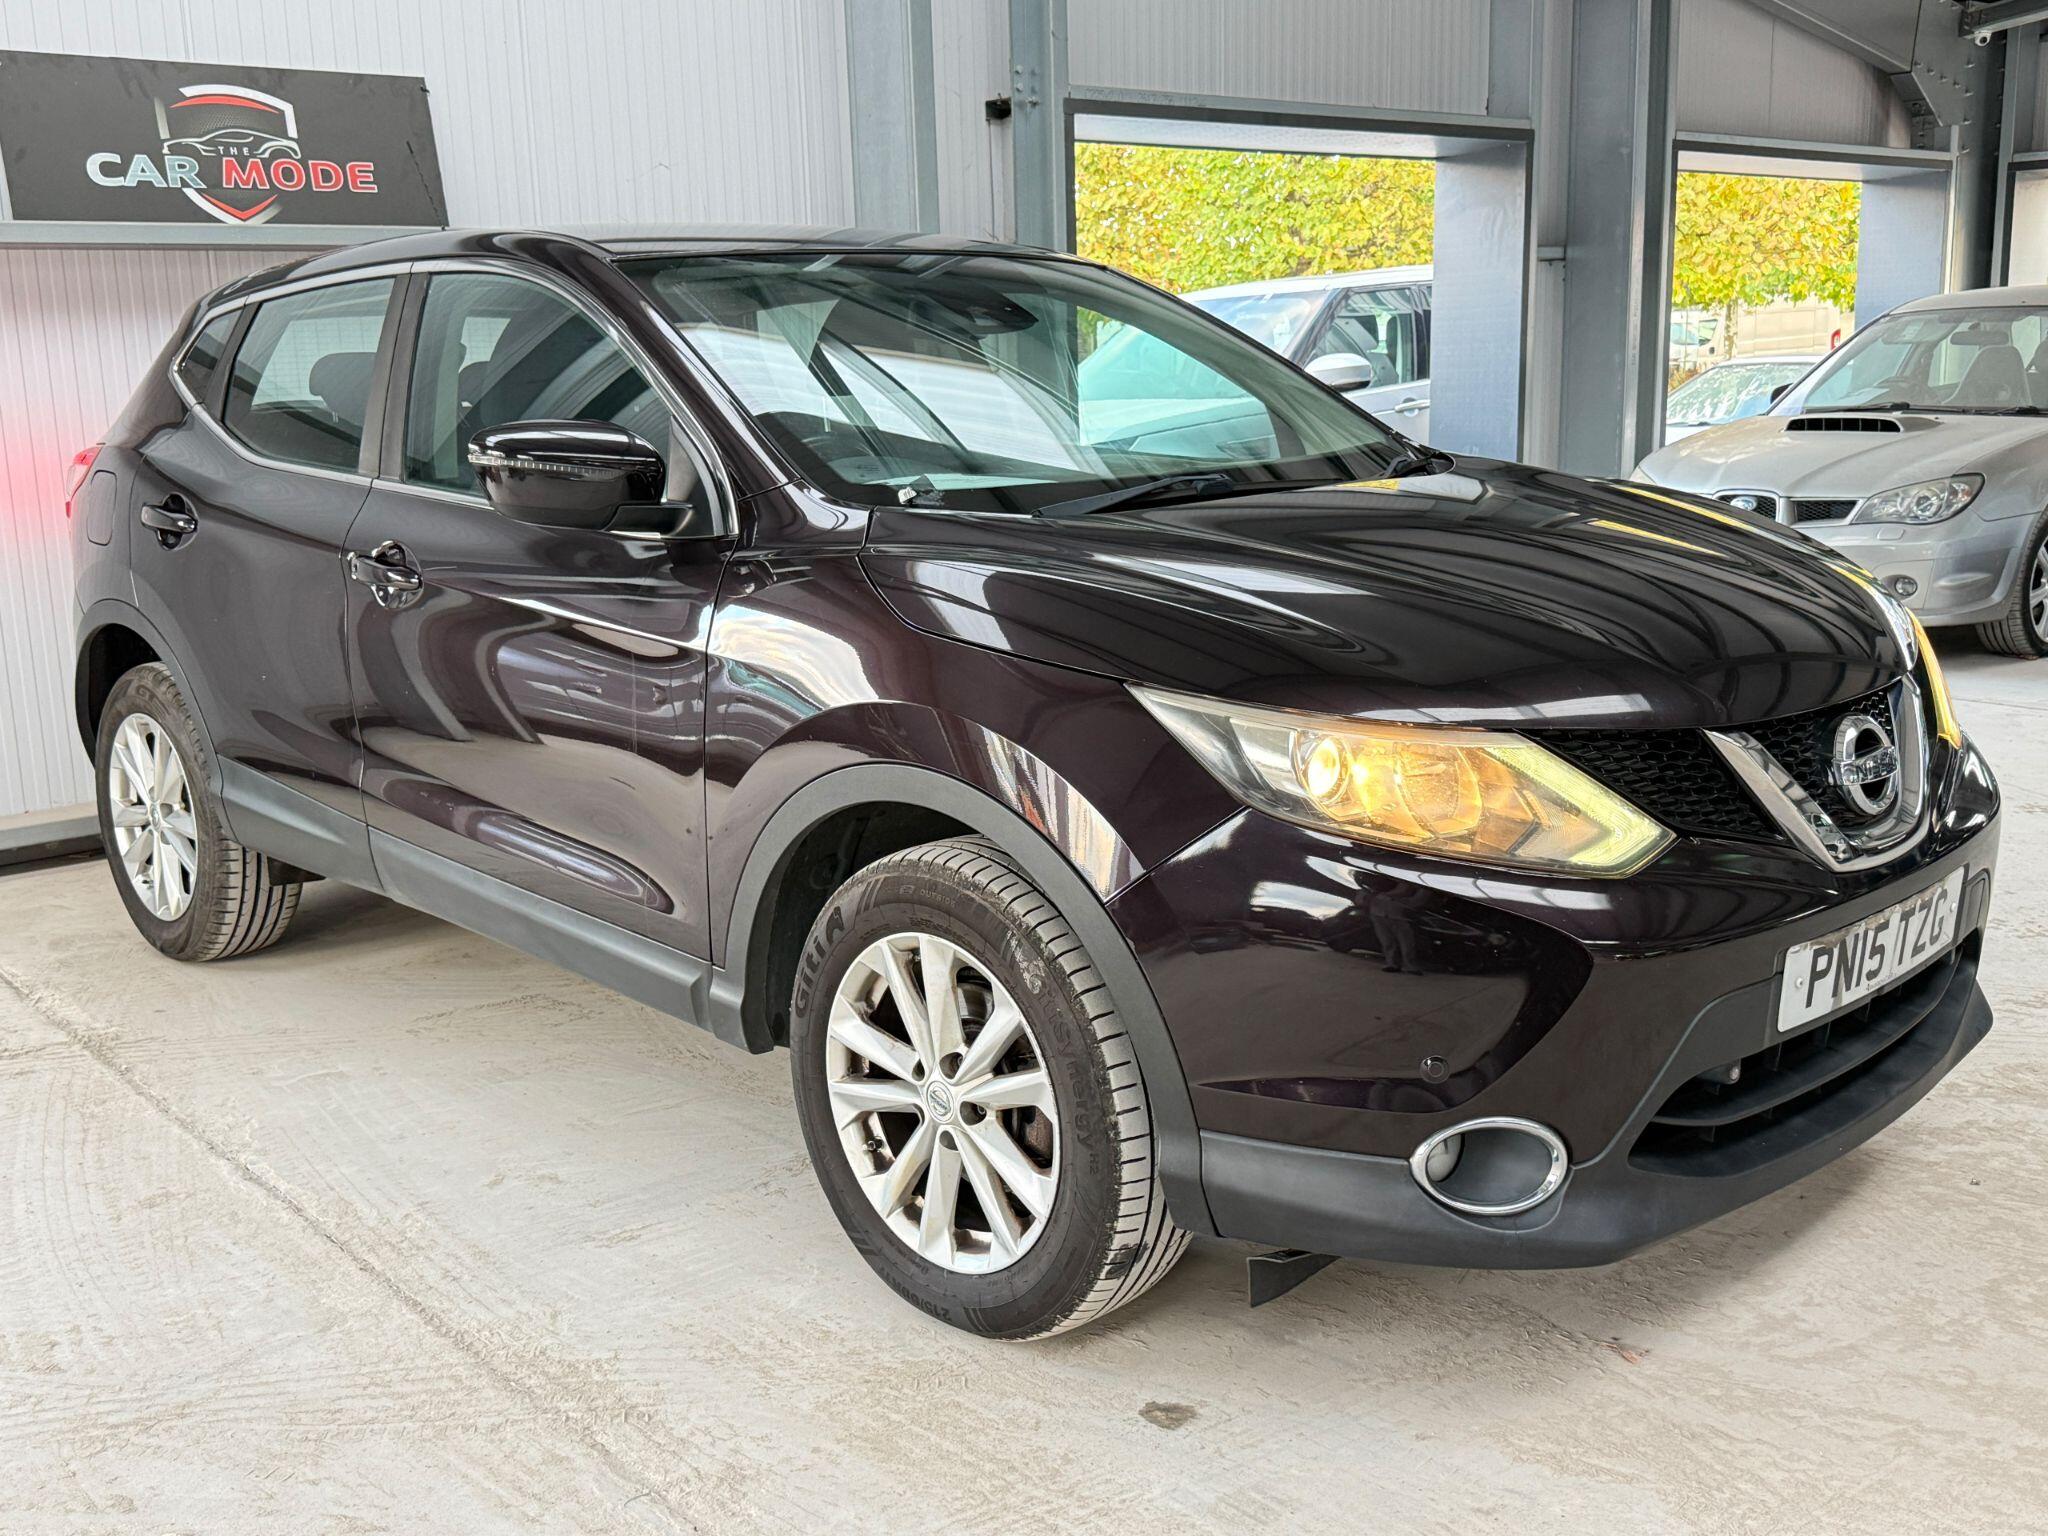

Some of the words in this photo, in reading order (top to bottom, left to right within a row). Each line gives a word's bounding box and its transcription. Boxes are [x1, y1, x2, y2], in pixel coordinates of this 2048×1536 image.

[217, 145, 250, 157] THE
[87, 152, 207, 189] CAR
[222, 157, 378, 193] MODE
[1806, 921, 1890, 1009] PN15
[1897, 888, 1948, 966] TZG
